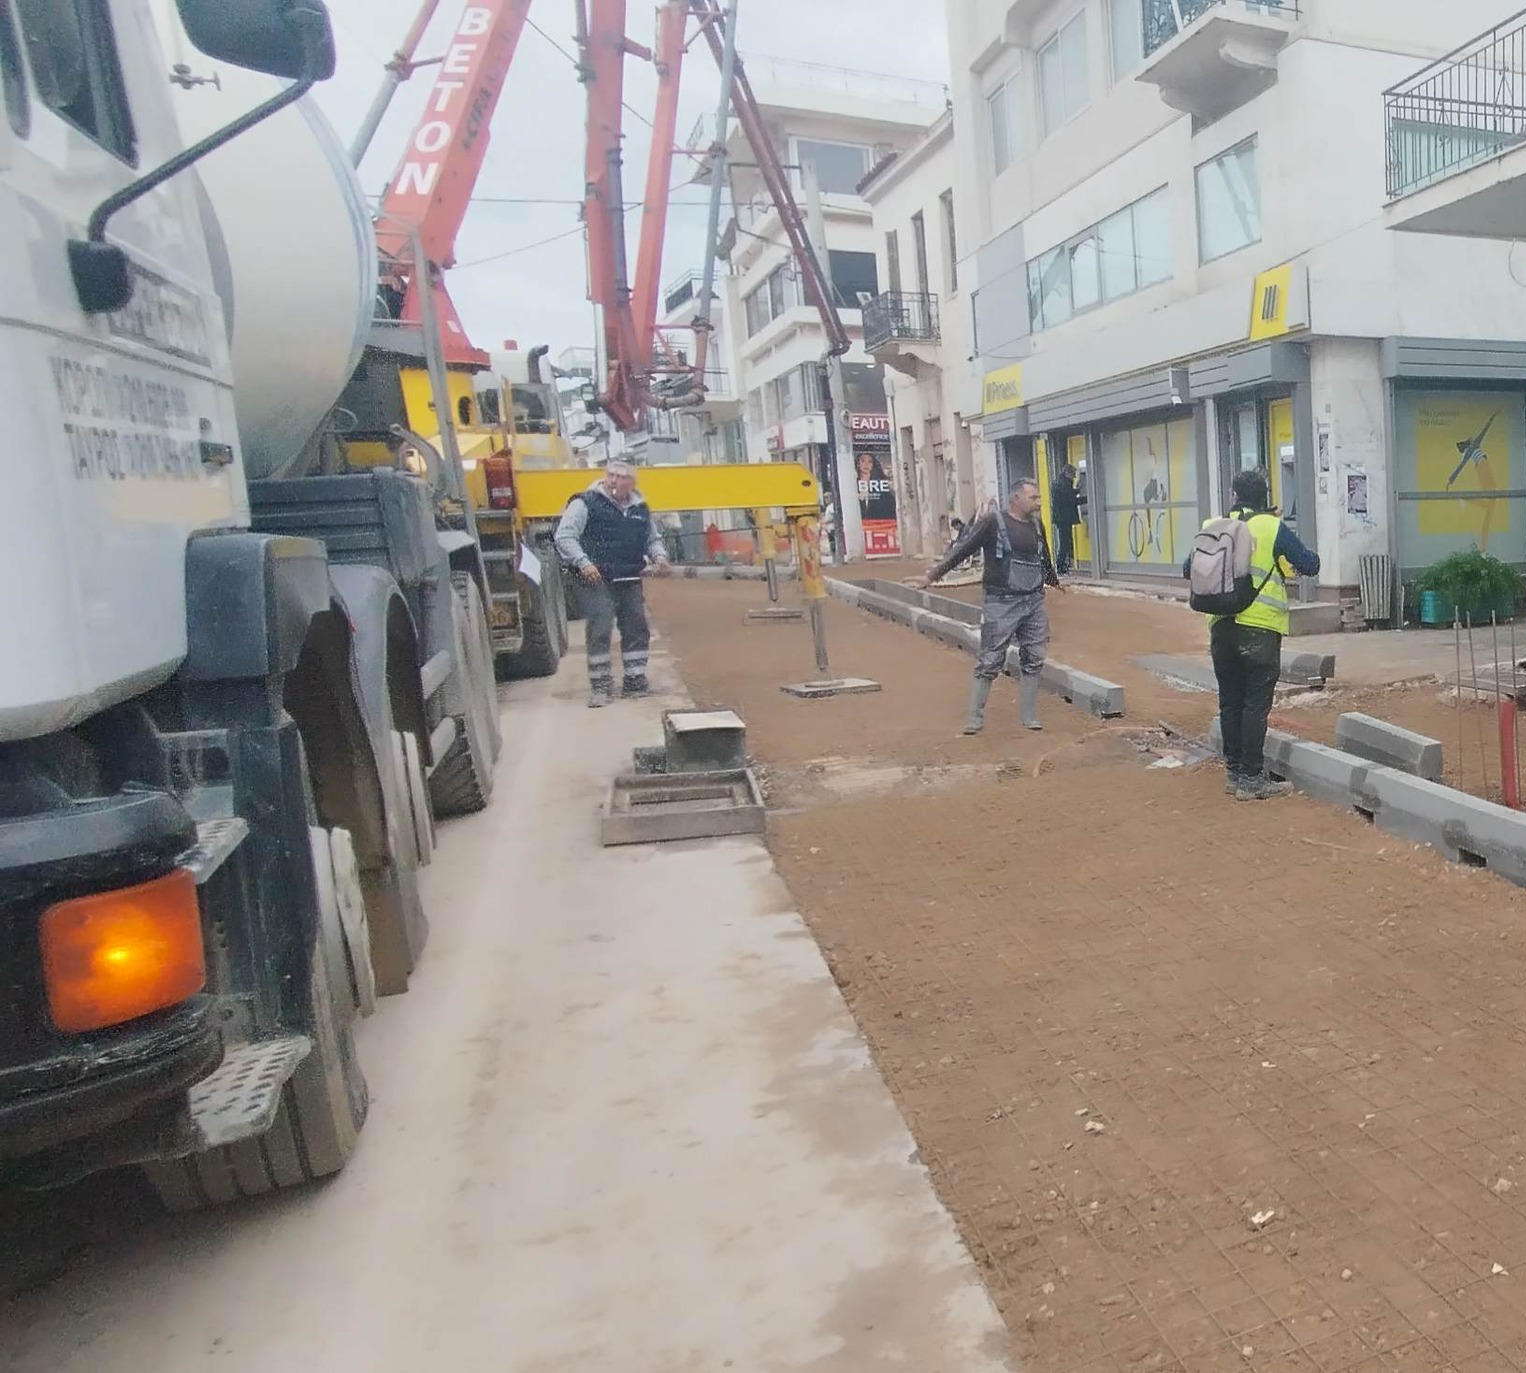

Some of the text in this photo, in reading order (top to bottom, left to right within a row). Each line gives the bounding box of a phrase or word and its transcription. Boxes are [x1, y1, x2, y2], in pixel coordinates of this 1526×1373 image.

[395, 7, 491, 195] BETON
[852, 418, 891, 430] EAUT
[858, 480, 890, 492] BRE
